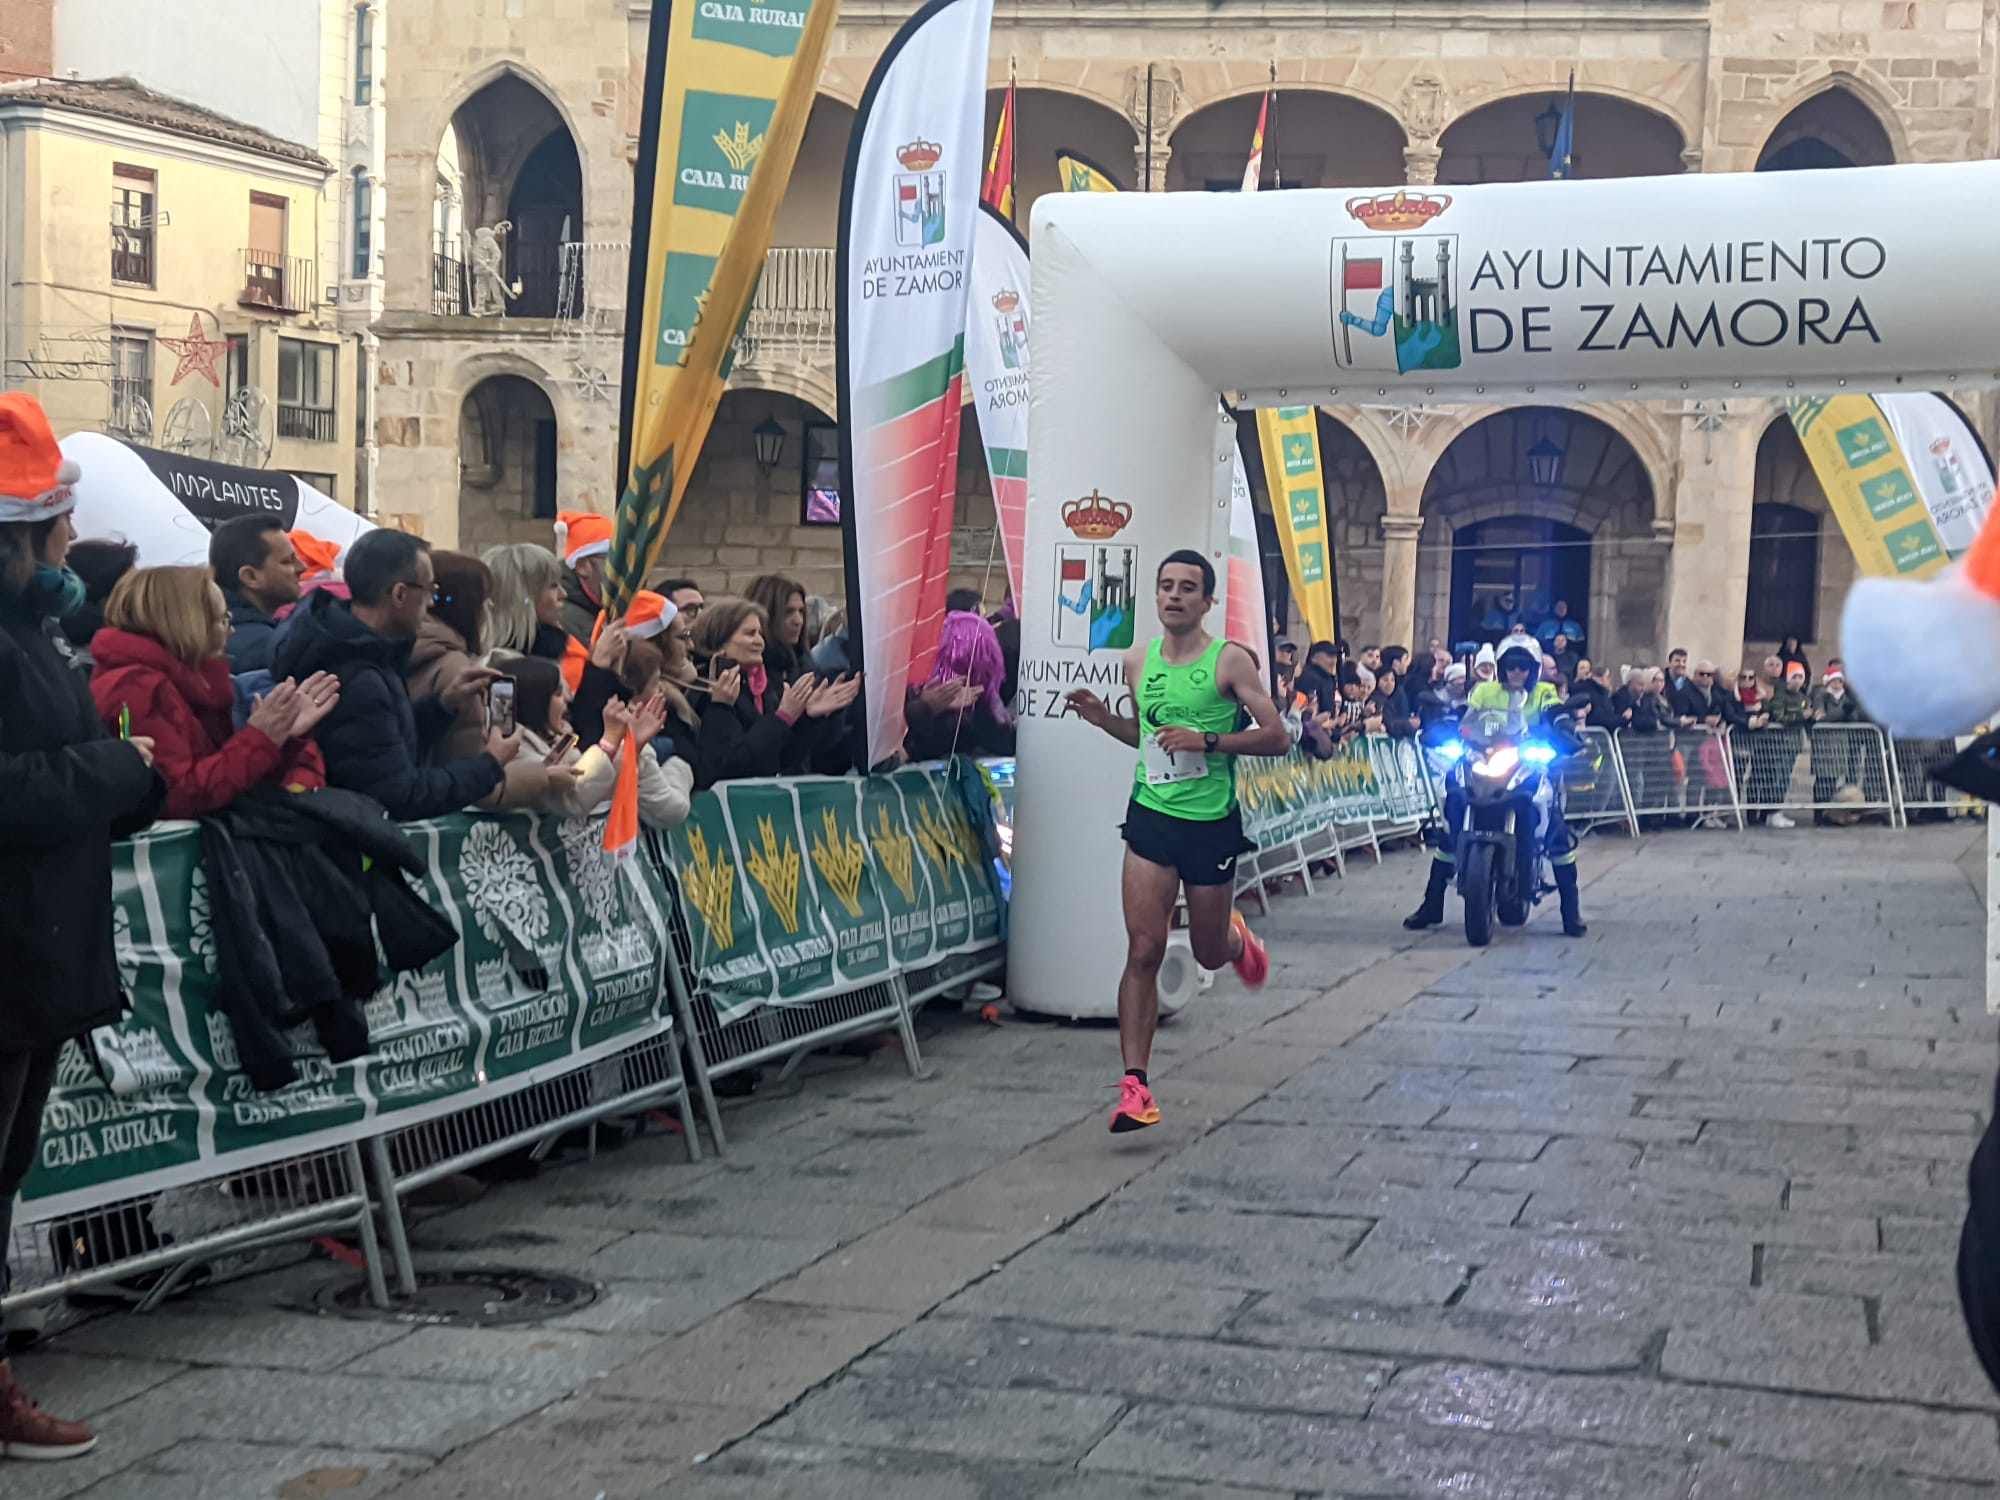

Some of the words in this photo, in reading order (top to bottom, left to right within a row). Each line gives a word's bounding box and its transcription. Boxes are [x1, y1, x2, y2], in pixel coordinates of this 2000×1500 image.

[700, 2, 745, 22] CAJA
[680, 167, 726, 189] CAJA
[1469, 236, 1887, 291] AYUNTAMIENTO
[863, 276, 887, 300] DE
[1469, 305, 1553, 354] DE
[1577, 295, 1882, 352] ZAMORA
[169, 471, 283, 511] IMPLANTES
[1018, 688, 1037, 718] DE
[495, 1030, 525, 1058] CAJA
[525, 1018, 565, 1050] RURAL
[42, 1130, 99, 1169] CAJA
[100, 1113, 177, 1156] RURAL
